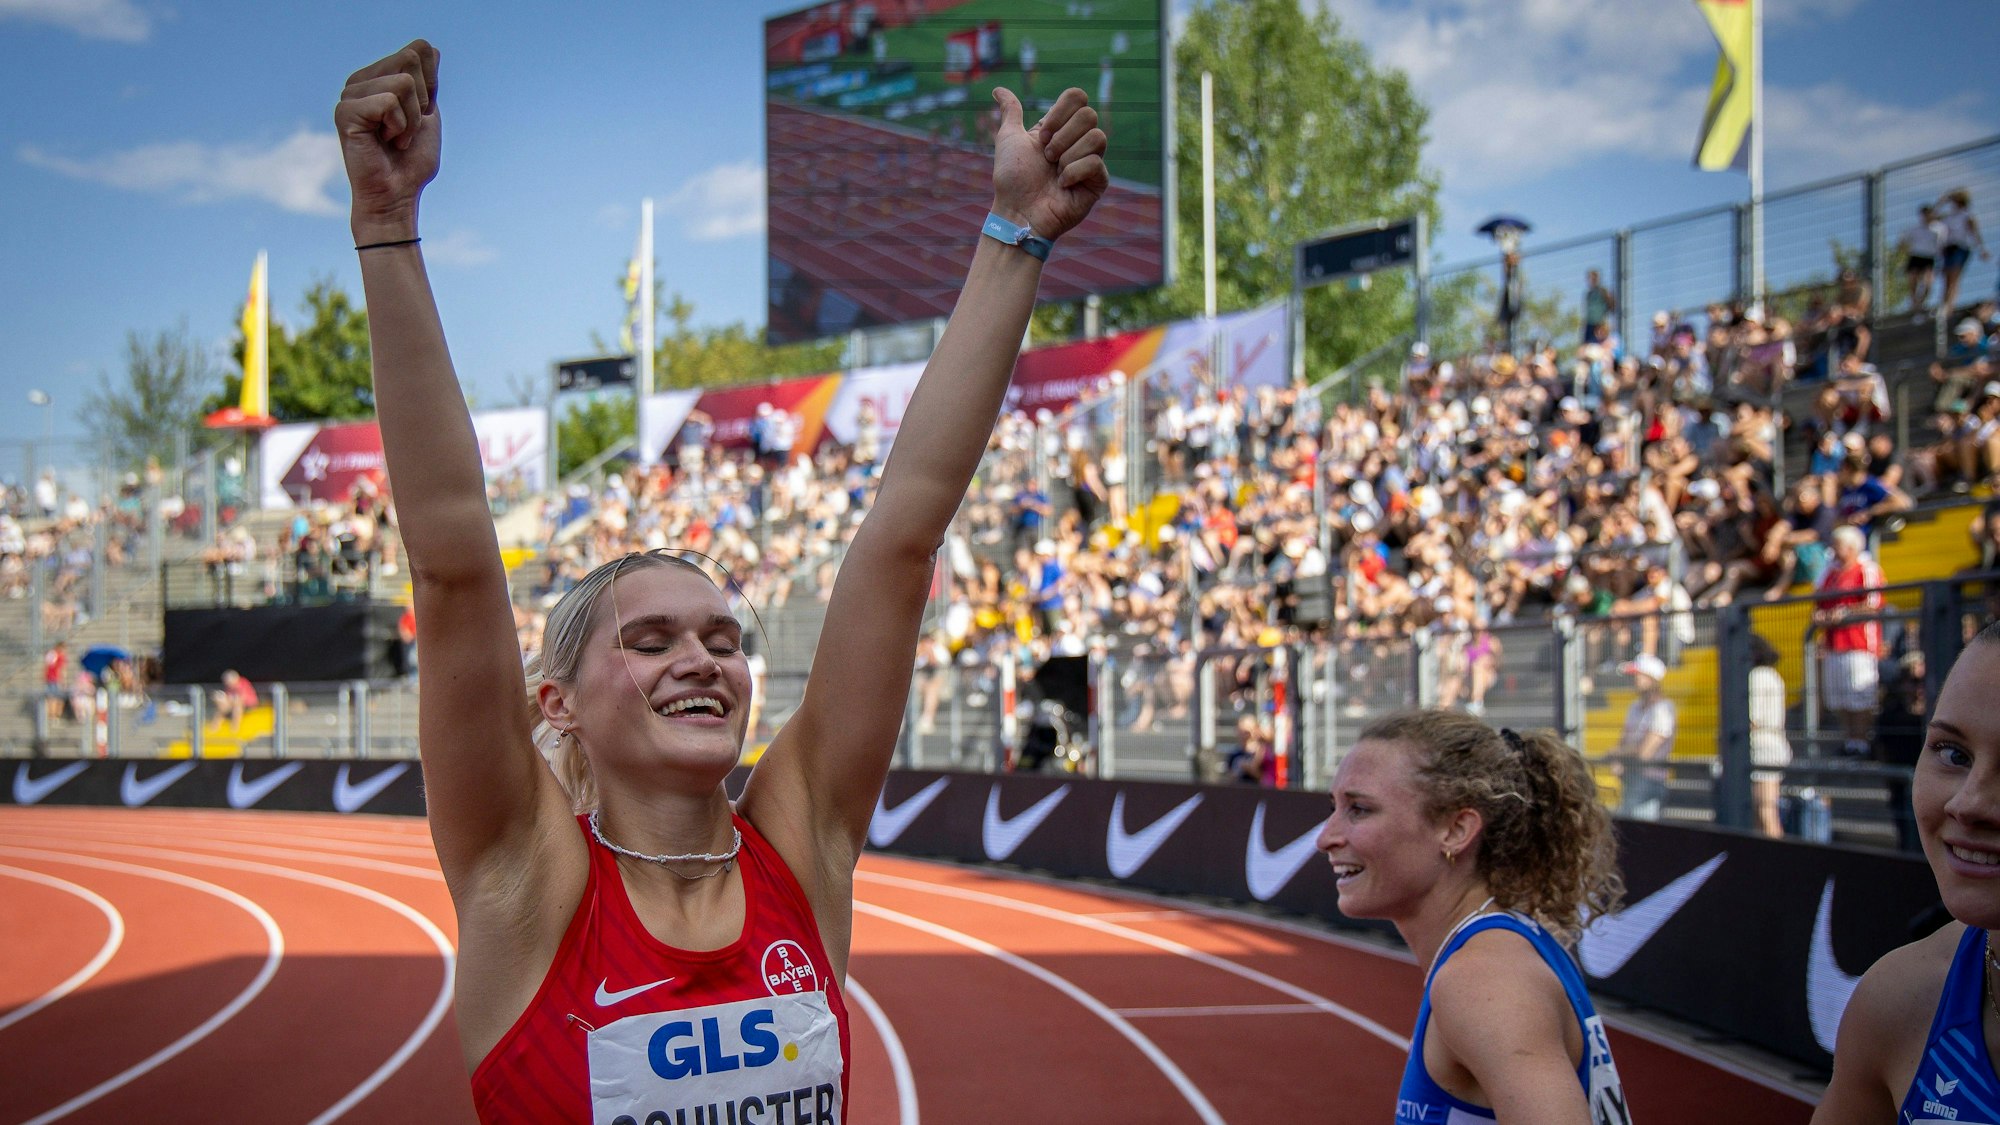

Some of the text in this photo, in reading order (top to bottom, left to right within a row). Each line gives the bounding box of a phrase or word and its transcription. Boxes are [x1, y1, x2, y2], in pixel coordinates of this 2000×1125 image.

[768, 964, 813, 987] BAYER
[777, 946, 803, 992] BAYE
[611, 1083, 835, 1125] STER
[1923, 1099, 1958, 1121] erima
